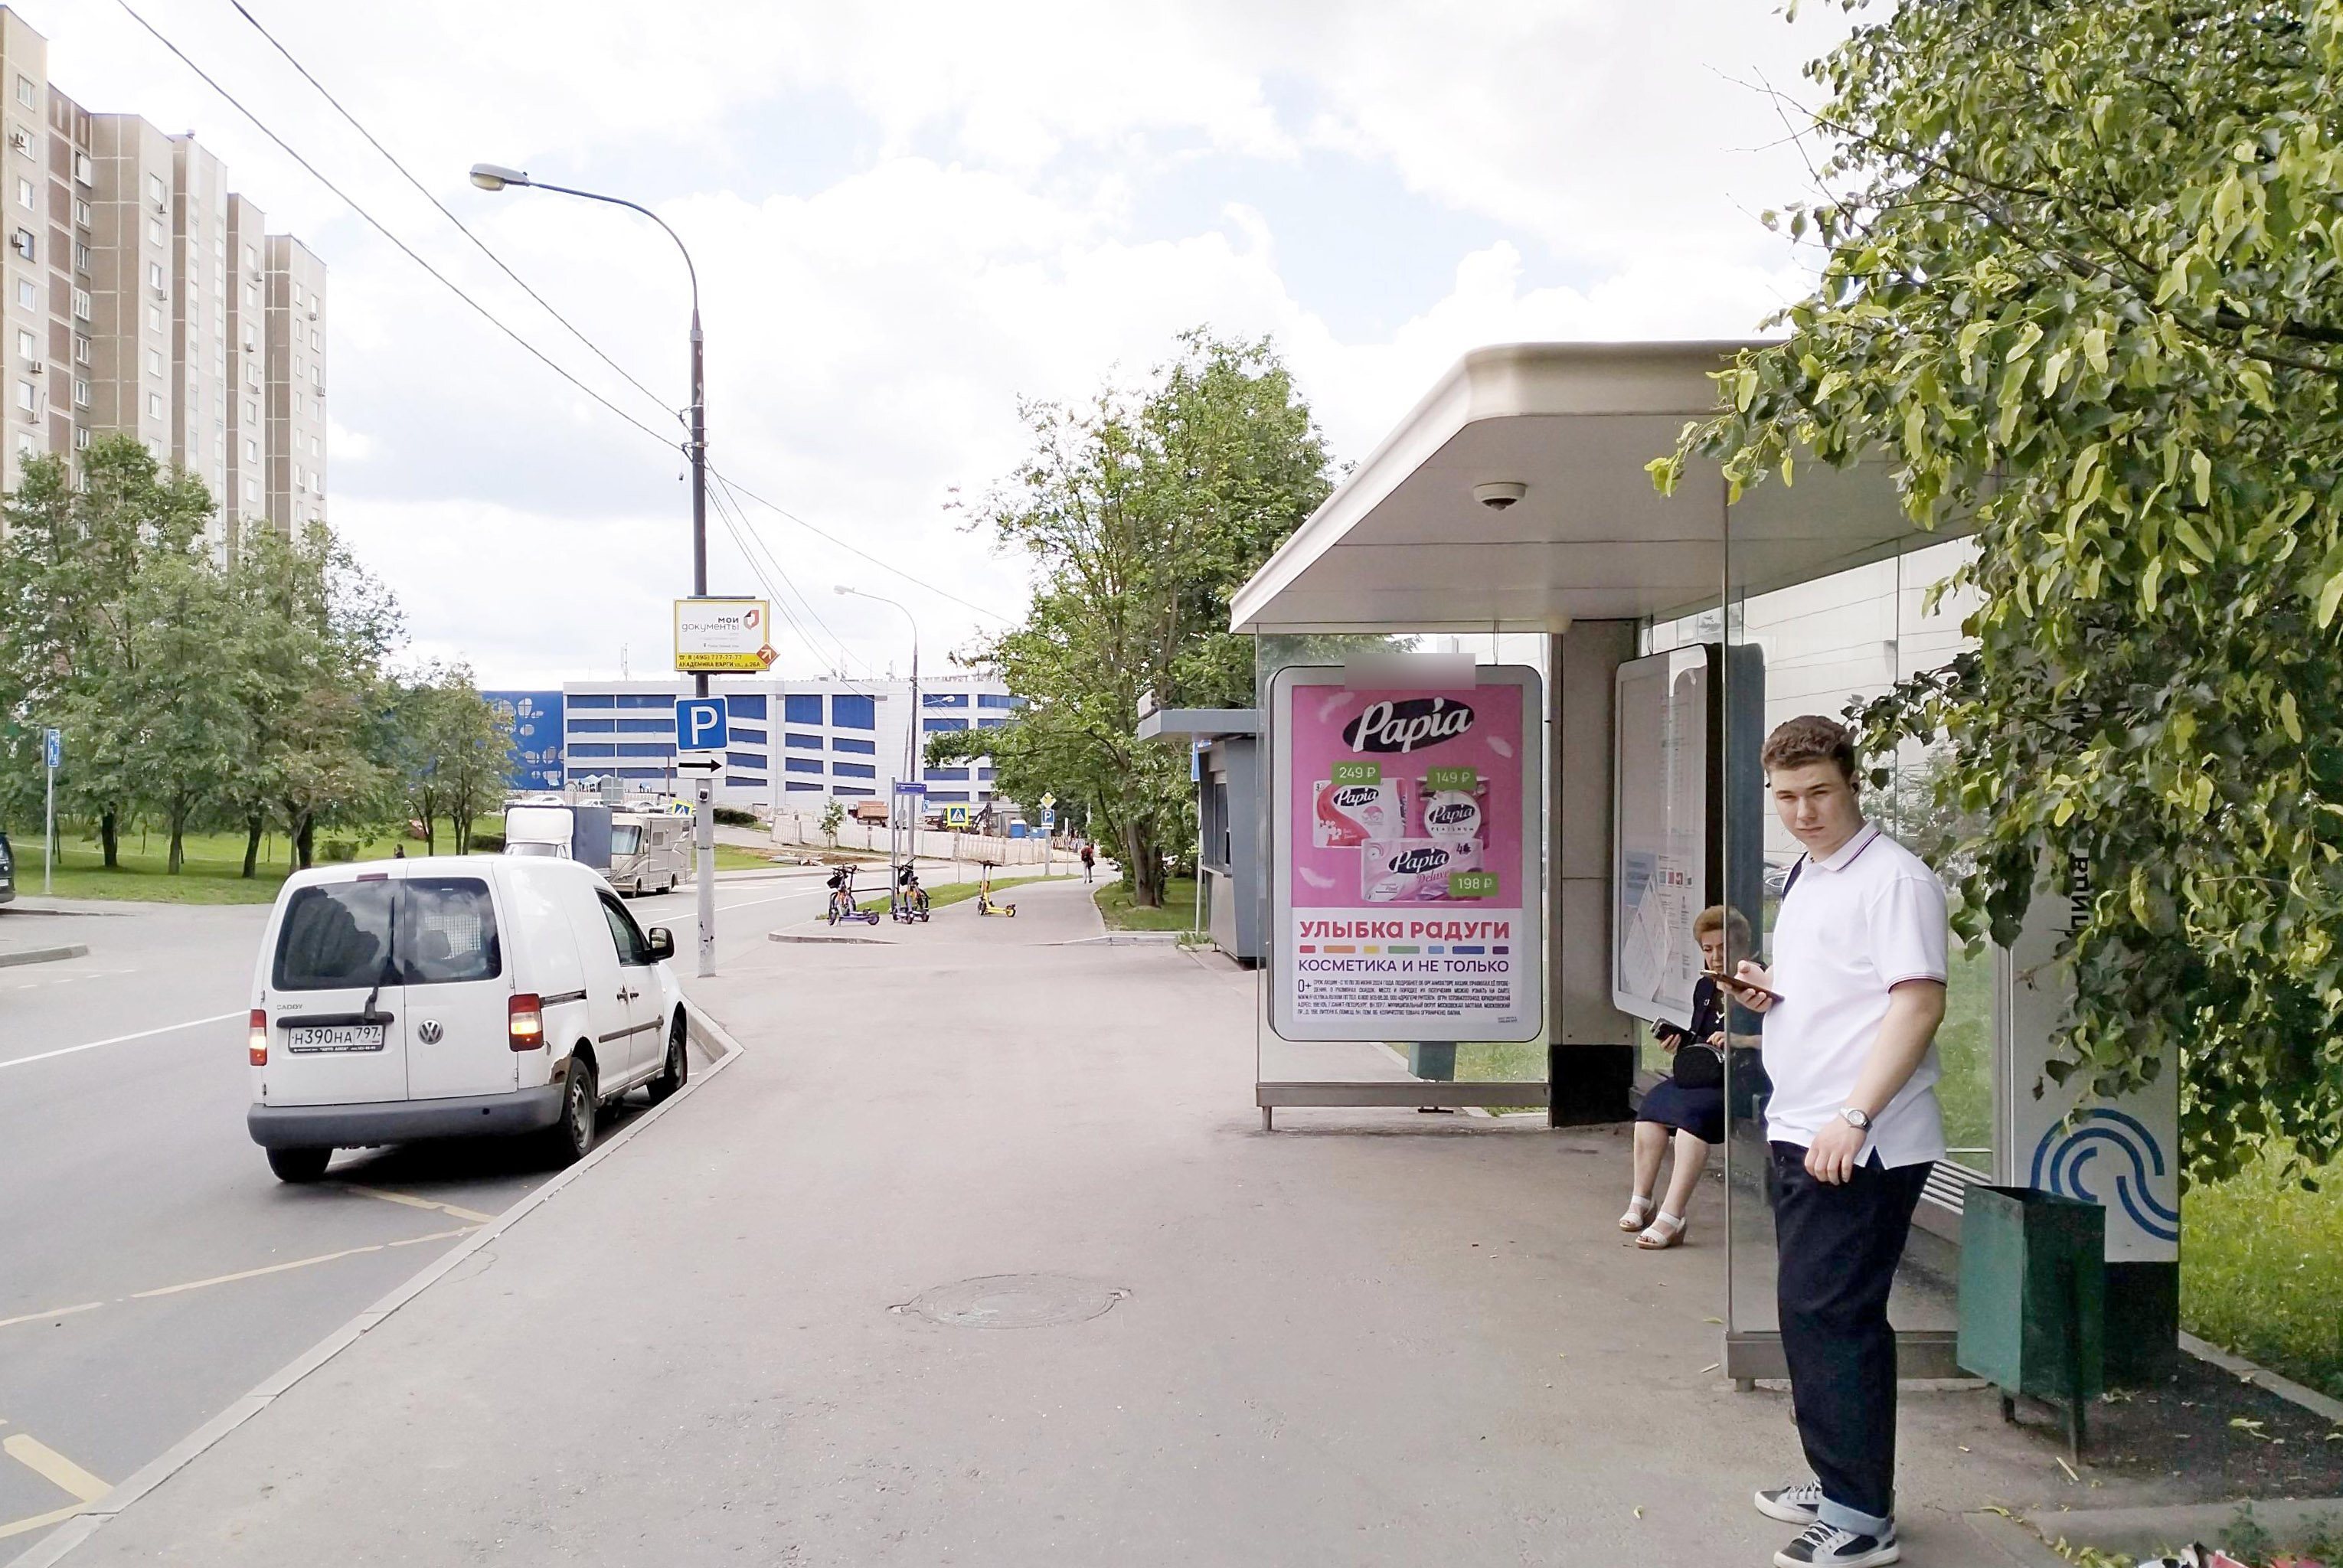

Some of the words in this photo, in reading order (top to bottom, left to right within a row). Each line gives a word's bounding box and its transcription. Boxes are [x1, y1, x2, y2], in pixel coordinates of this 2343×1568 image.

[681, 623, 740, 632] документы
[691, 706, 718, 745] P
[1352, 697, 1473, 753] Papia
[1339, 767, 1363, 778] 249
[1436, 772, 1458, 783] 149
[1337, 788, 1378, 807] Papia
[1044, 812, 1052, 821] P
[1433, 803, 1473, 824] Papia
[1393, 848, 1447, 874] Papia
[1458, 878, 1480, 890] 198
[1299, 960, 1397, 972] КОСМЕТИКА
[1403, 960, 1413, 972] И
[1419, 960, 1439, 972] НЕ
[1443, 960, 1509, 972] ТОЛЬКО
[1298, 979, 1312, 992] 0+
[355, 1027, 378, 1038] 797
